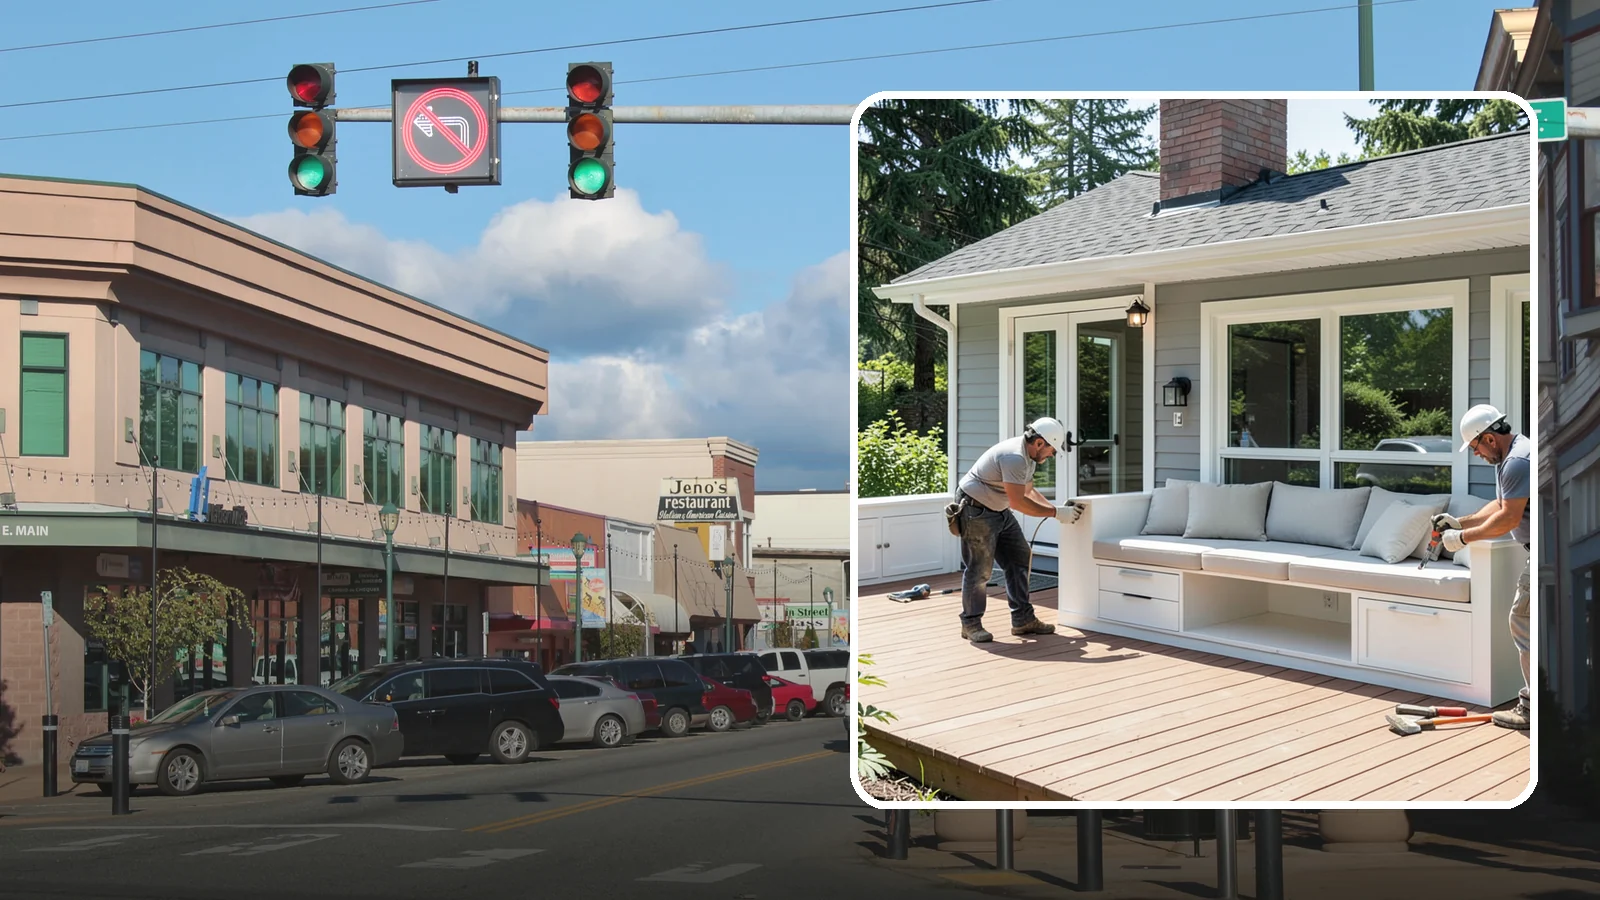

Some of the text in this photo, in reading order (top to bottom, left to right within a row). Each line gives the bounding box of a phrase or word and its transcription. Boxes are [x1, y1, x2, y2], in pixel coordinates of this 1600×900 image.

[670, 480, 727, 494] Jeno's
[665, 496, 731, 509] restaurant
[686, 509, 714, 519] American
[715, 509, 737, 519] Cuisine
[2, 525, 49, 536] E. MAIN
[797, 607, 828, 617] Street
